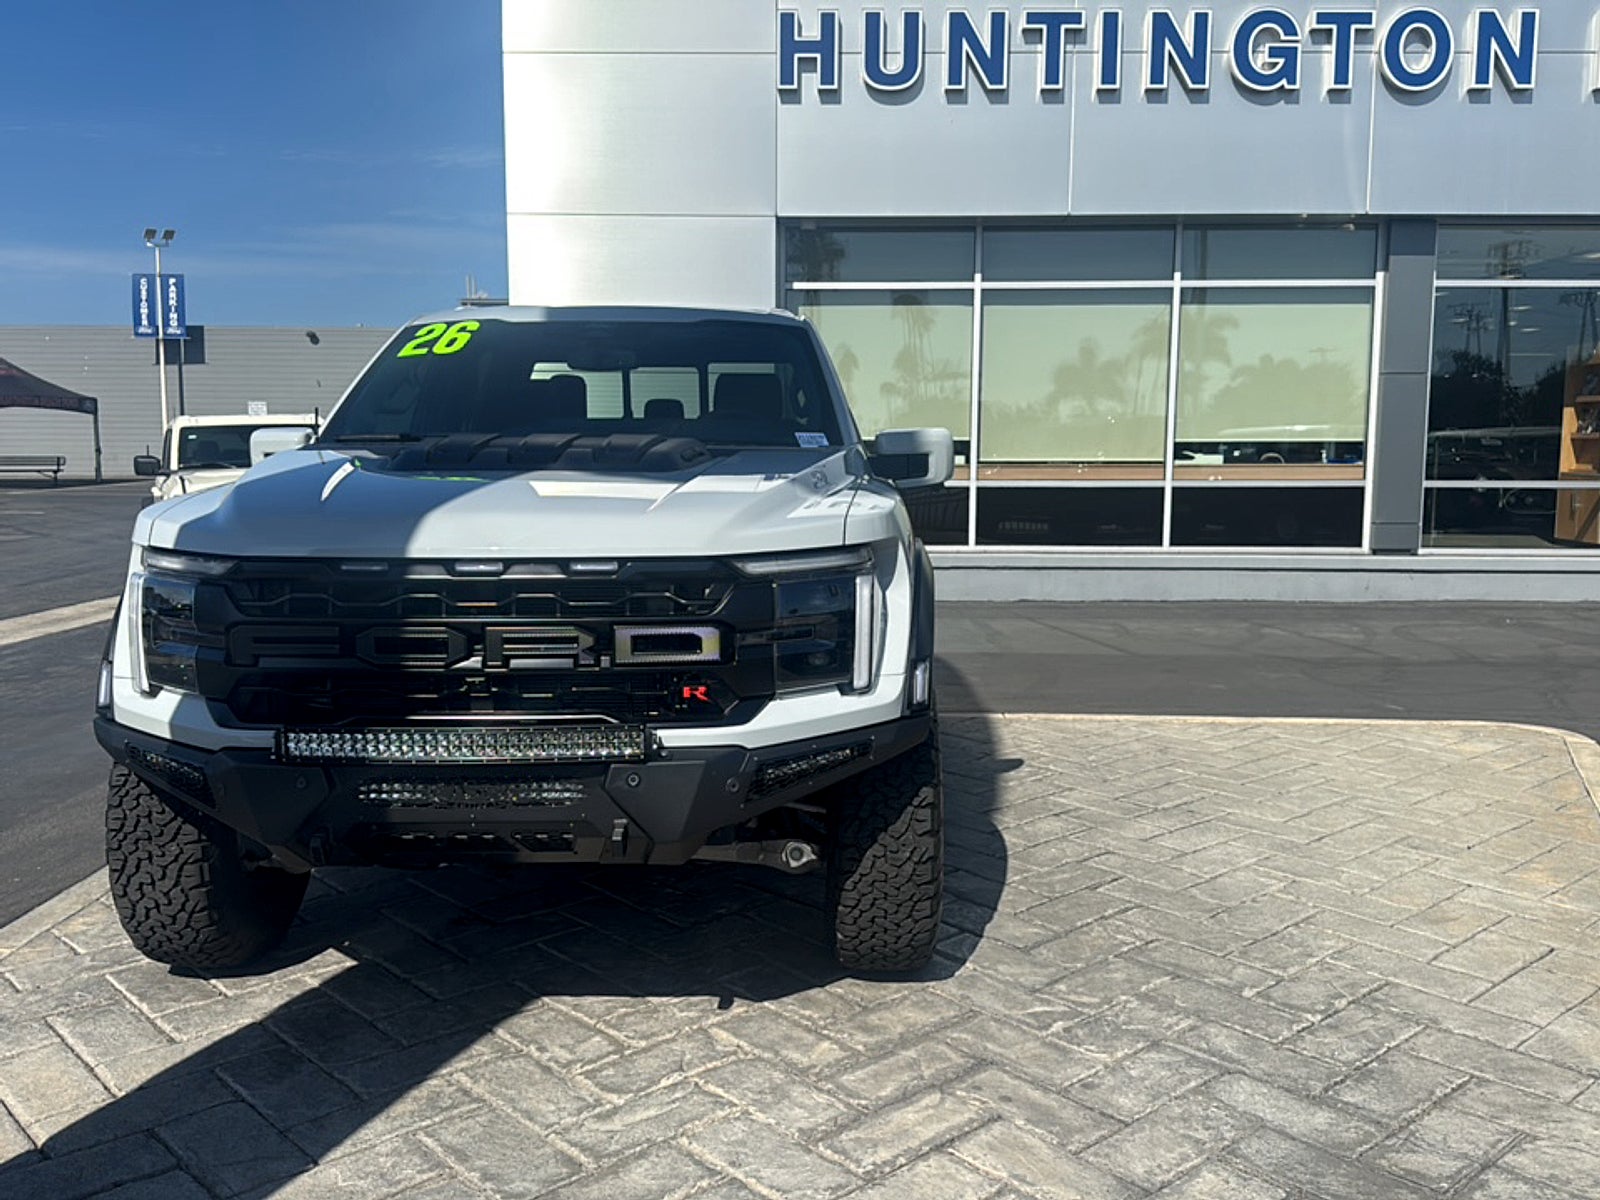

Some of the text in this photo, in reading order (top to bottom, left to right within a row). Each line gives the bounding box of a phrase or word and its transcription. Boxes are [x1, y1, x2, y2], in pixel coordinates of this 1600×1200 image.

[777, 7, 1540, 91] HUNTINGTON
[168, 277, 178, 327] PARKING
[397, 320, 480, 358] 26
[228, 623, 722, 668] FORD
